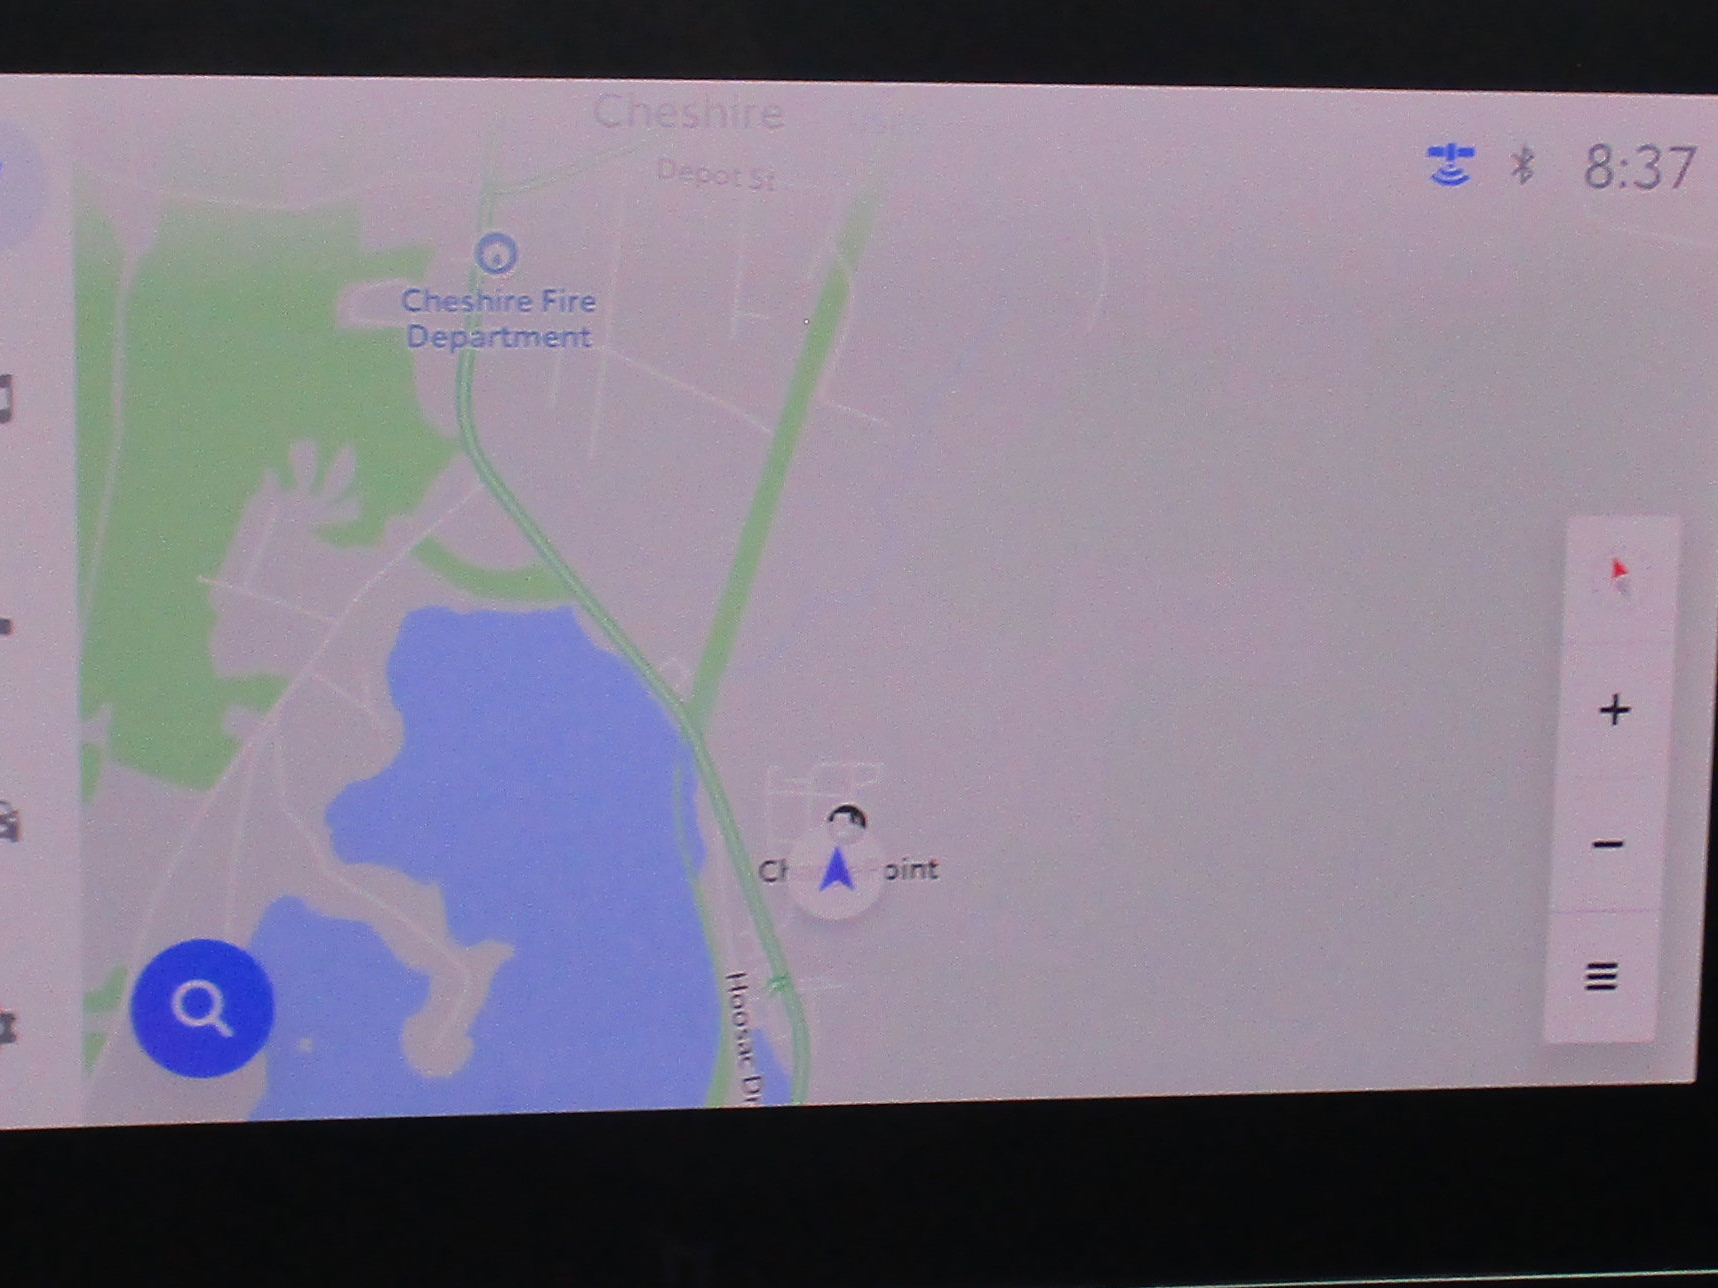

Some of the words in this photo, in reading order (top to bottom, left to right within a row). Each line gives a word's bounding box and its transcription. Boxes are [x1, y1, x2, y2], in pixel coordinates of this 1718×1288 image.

[592, 92, 785, 132] Cheshire
[656, 157, 743, 189] Depot
[748, 168, 778, 193] St
[1584, 142, 1699, 190] 8:37
[401, 287, 533, 313] Cheshire
[541, 288, 597, 313] Fire
[407, 323, 593, 353] Department
[724, 972, 753, 1069] Hoosac
